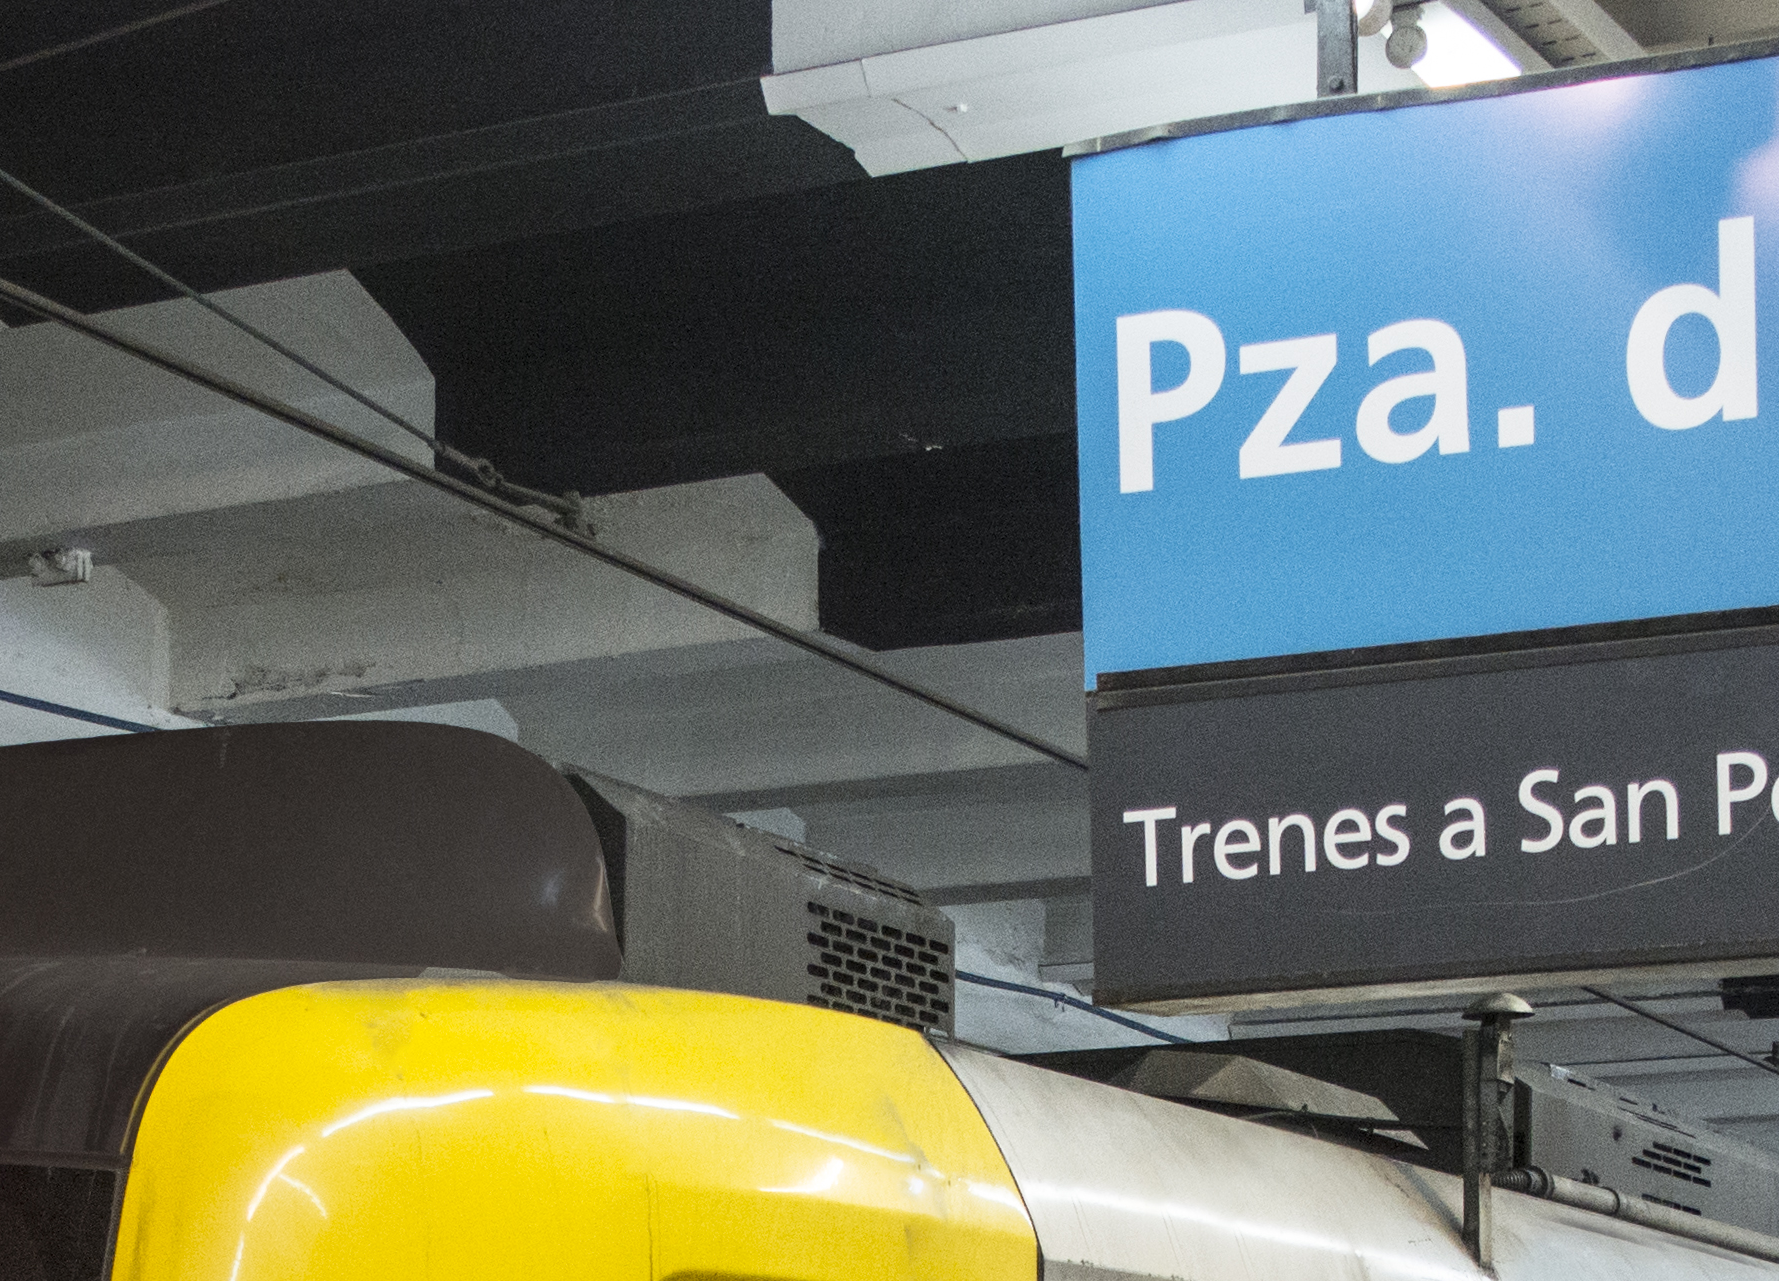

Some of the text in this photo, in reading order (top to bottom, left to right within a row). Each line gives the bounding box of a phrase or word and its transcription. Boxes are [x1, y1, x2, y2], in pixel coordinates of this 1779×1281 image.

[1116, 309, 1535, 494] Pza.
[1123, 802, 1411, 887] Trenes
[1439, 797, 1486, 859] a
[1518, 768, 1679, 854] San
